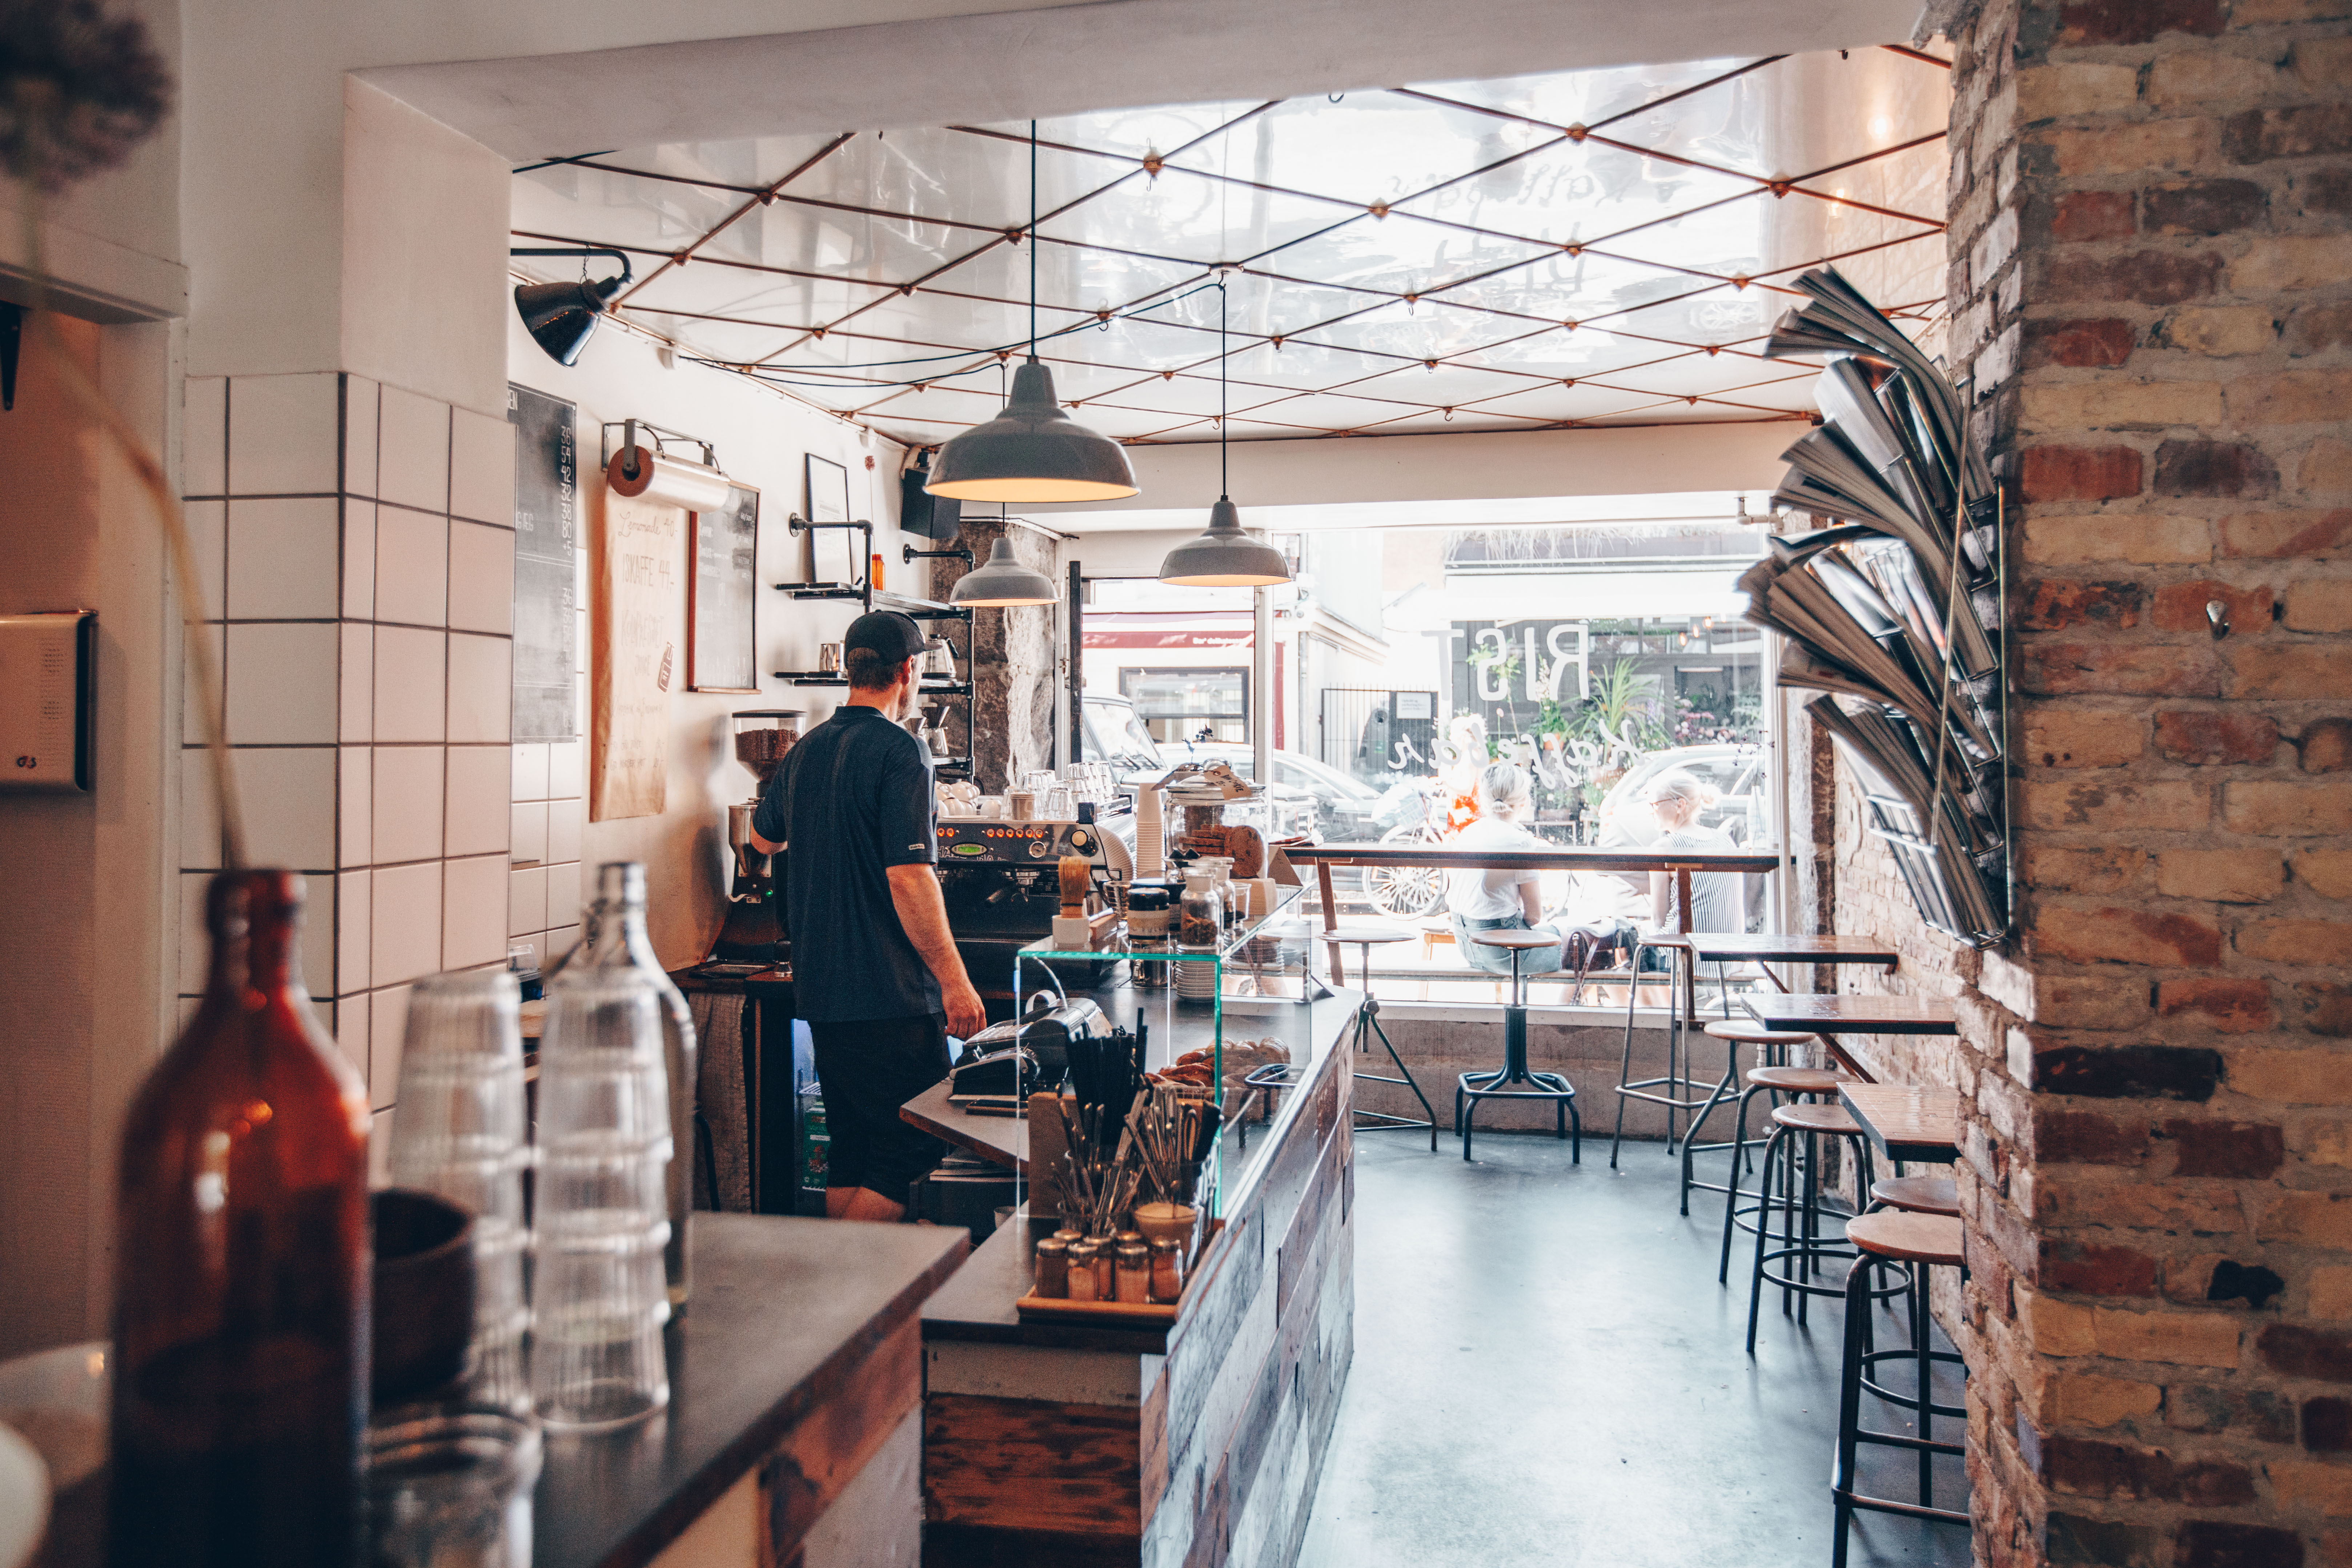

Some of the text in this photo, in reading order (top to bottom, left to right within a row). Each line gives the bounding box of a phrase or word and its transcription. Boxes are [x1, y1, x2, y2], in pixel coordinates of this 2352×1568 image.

[561, 426, 571, 445] 36
[561, 503, 572, 520] 38
[562, 521, 572, 538] 80
[618, 511, 661, 537] Lemonade
[622, 553, 654, 587] ISKAFFE
